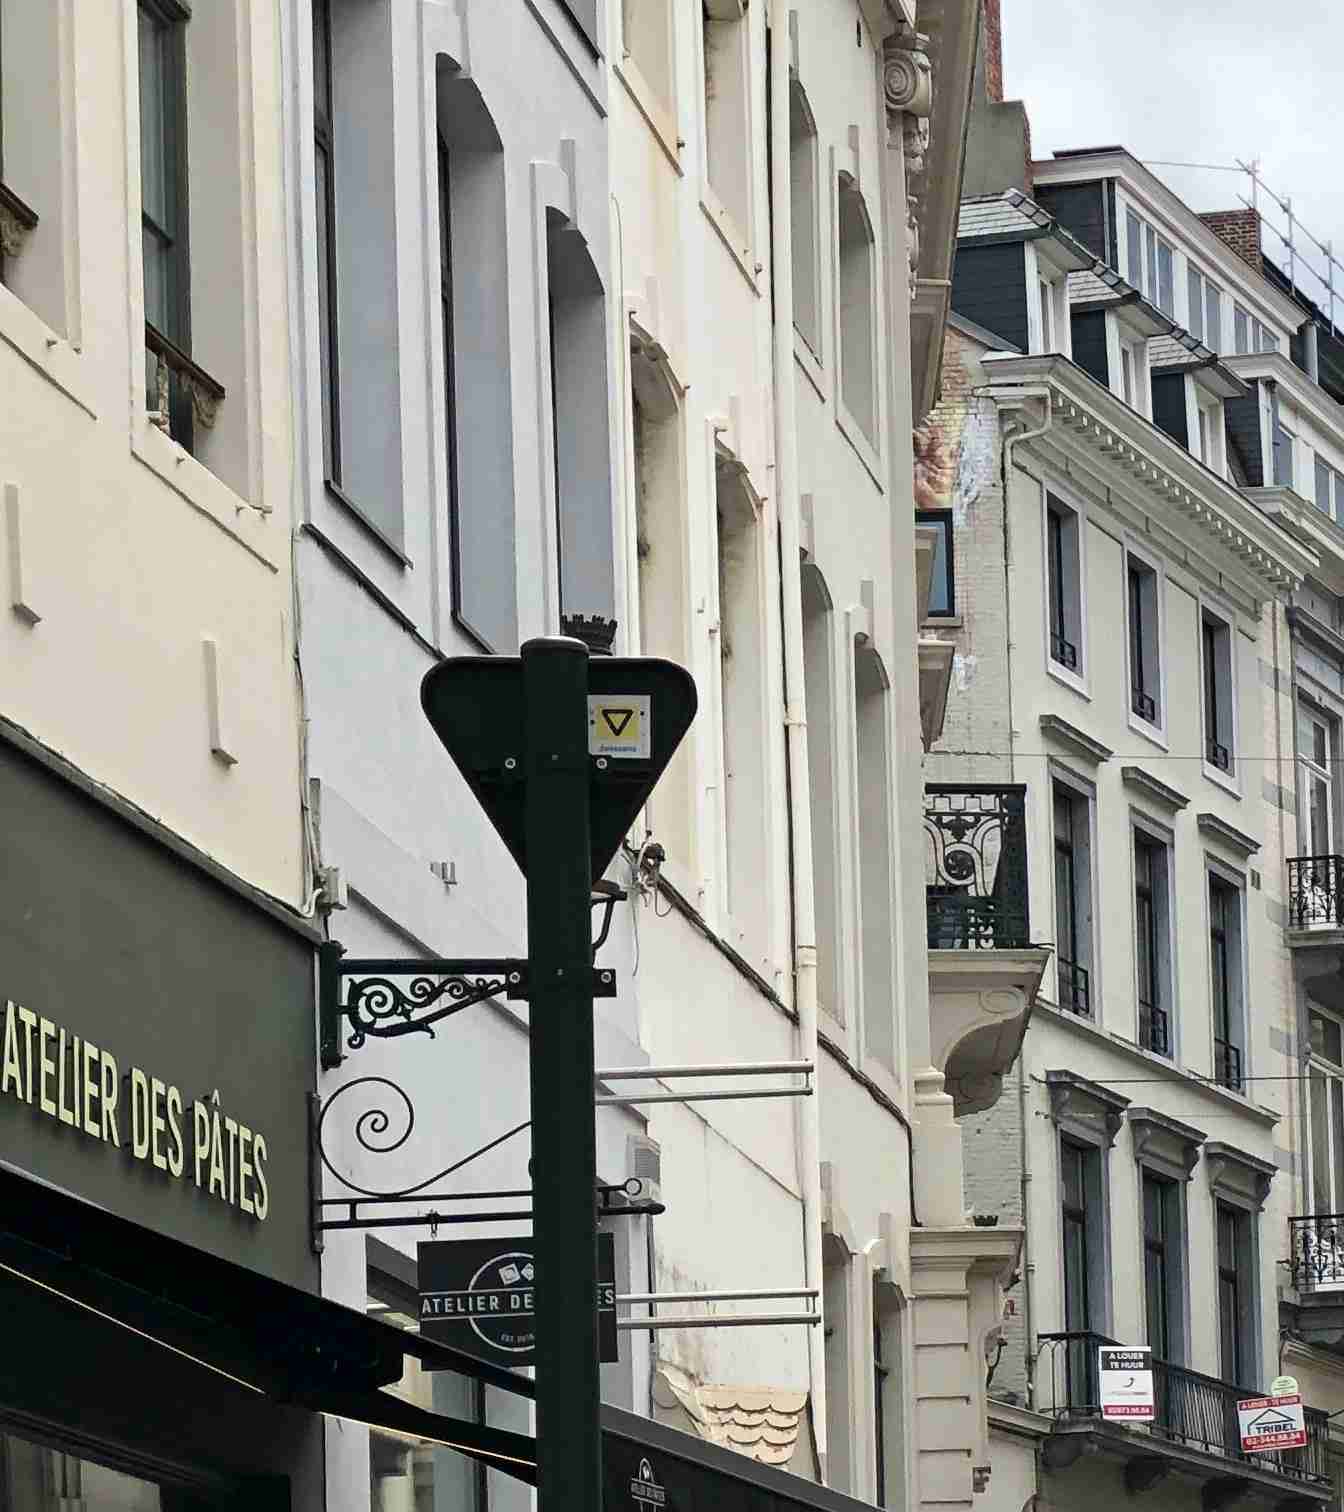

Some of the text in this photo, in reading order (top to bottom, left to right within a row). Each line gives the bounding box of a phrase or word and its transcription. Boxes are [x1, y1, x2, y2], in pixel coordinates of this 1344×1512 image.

[2, 1000, 268, 1221] ATELIER DES PÂTES
[422, 1292, 535, 1314] ATELIER DE
[1256, 1423, 1296, 1433] TRIBEL
